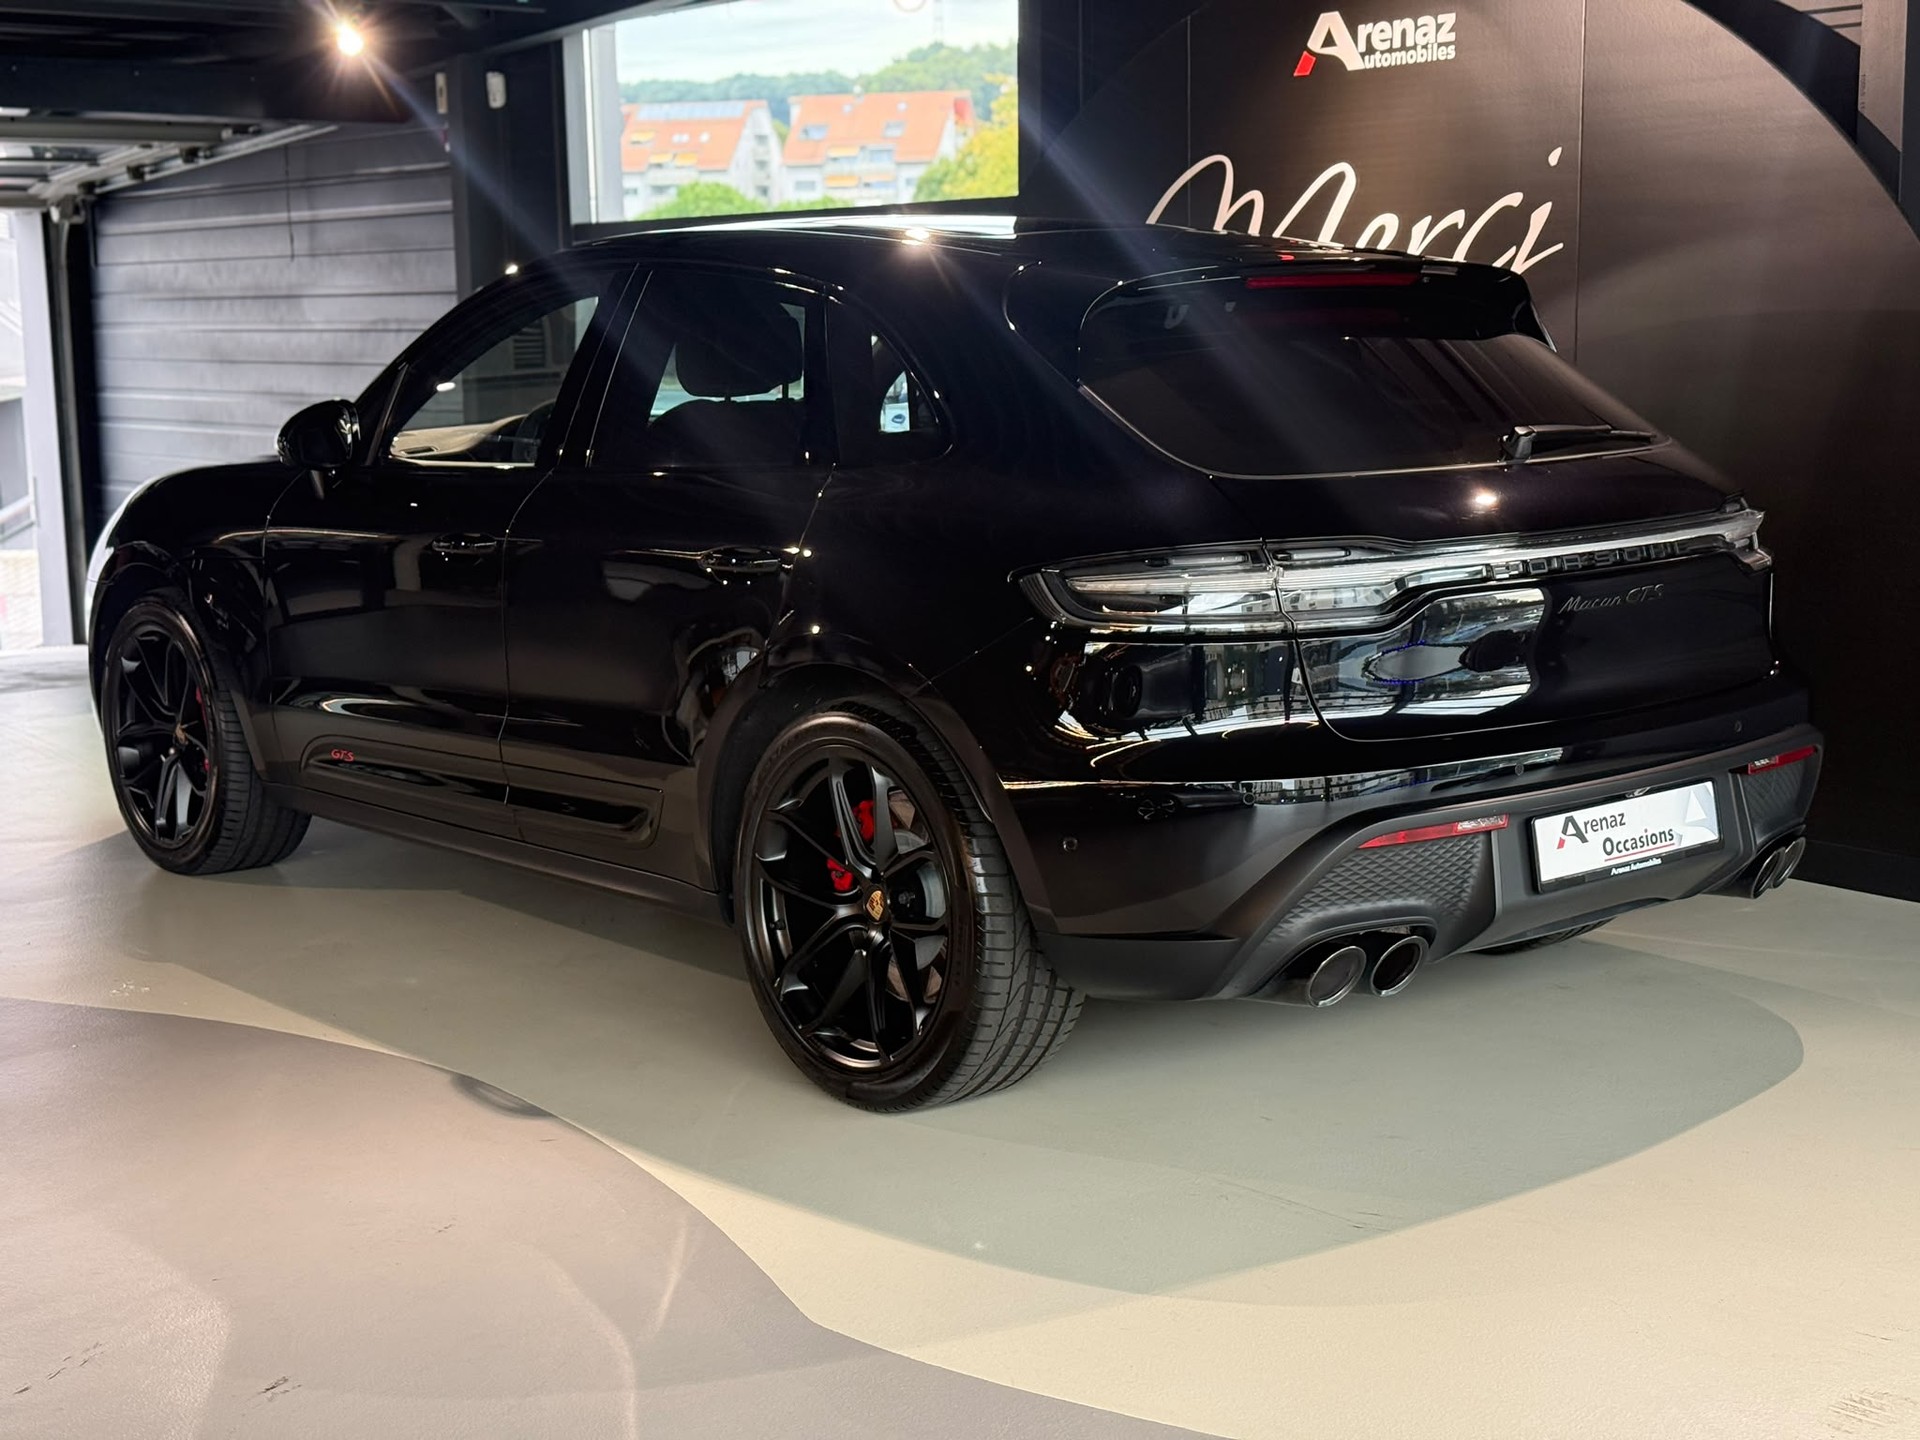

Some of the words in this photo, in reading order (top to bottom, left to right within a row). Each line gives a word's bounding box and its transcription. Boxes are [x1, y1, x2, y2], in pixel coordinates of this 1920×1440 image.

[1294, 11, 1456, 76] Arenaz
[1558, 595, 1622, 615] Macan
[1625, 583, 1665, 603] GTS
[331, 748, 354, 762] GTS
[1557, 812, 1626, 850] Arenaz
[1602, 828, 1675, 856] Occasions
